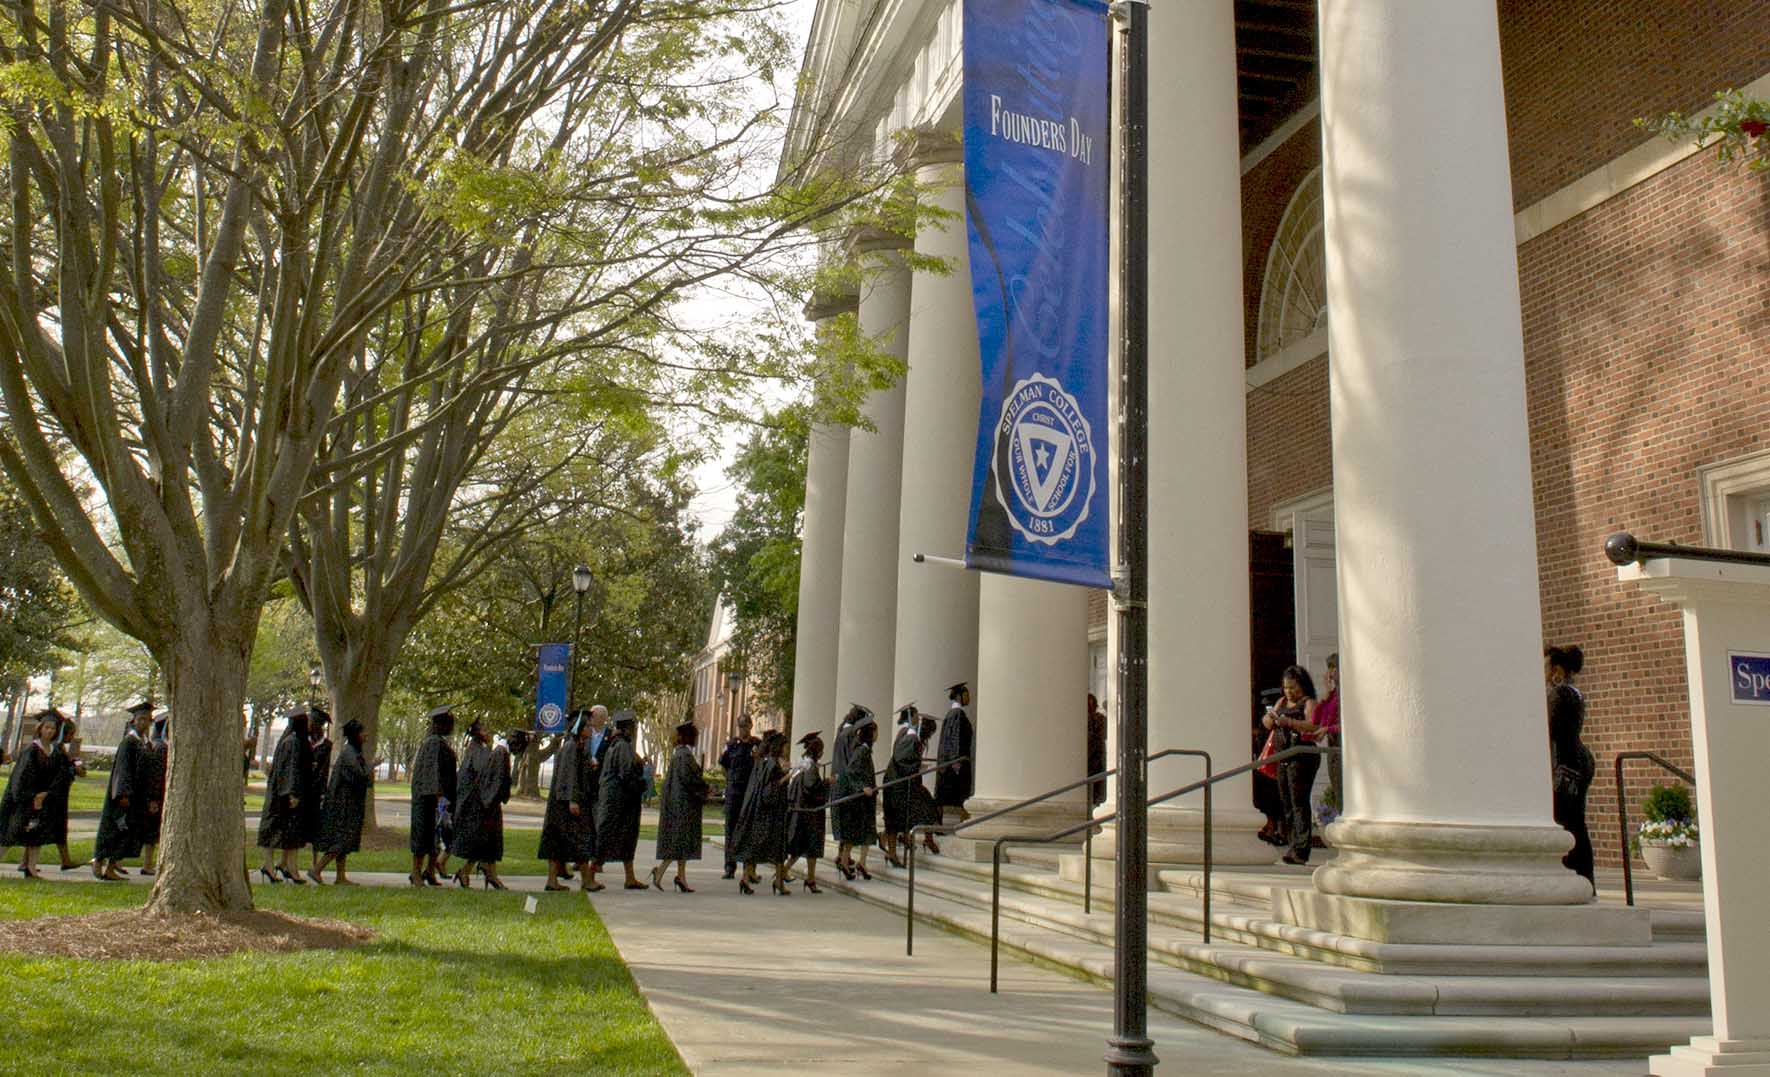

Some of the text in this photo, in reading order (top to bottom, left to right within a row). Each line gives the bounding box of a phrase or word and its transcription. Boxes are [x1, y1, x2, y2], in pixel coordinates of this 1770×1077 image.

[991, 94, 1092, 166] FOUNDERS DAY
[1002, 384, 1089, 454] SPELMAN COLLEGE
[1014, 438, 1023, 464] OUR
[1047, 472, 1071, 513] SCHOOL
[1029, 516, 1054, 534] 1881
